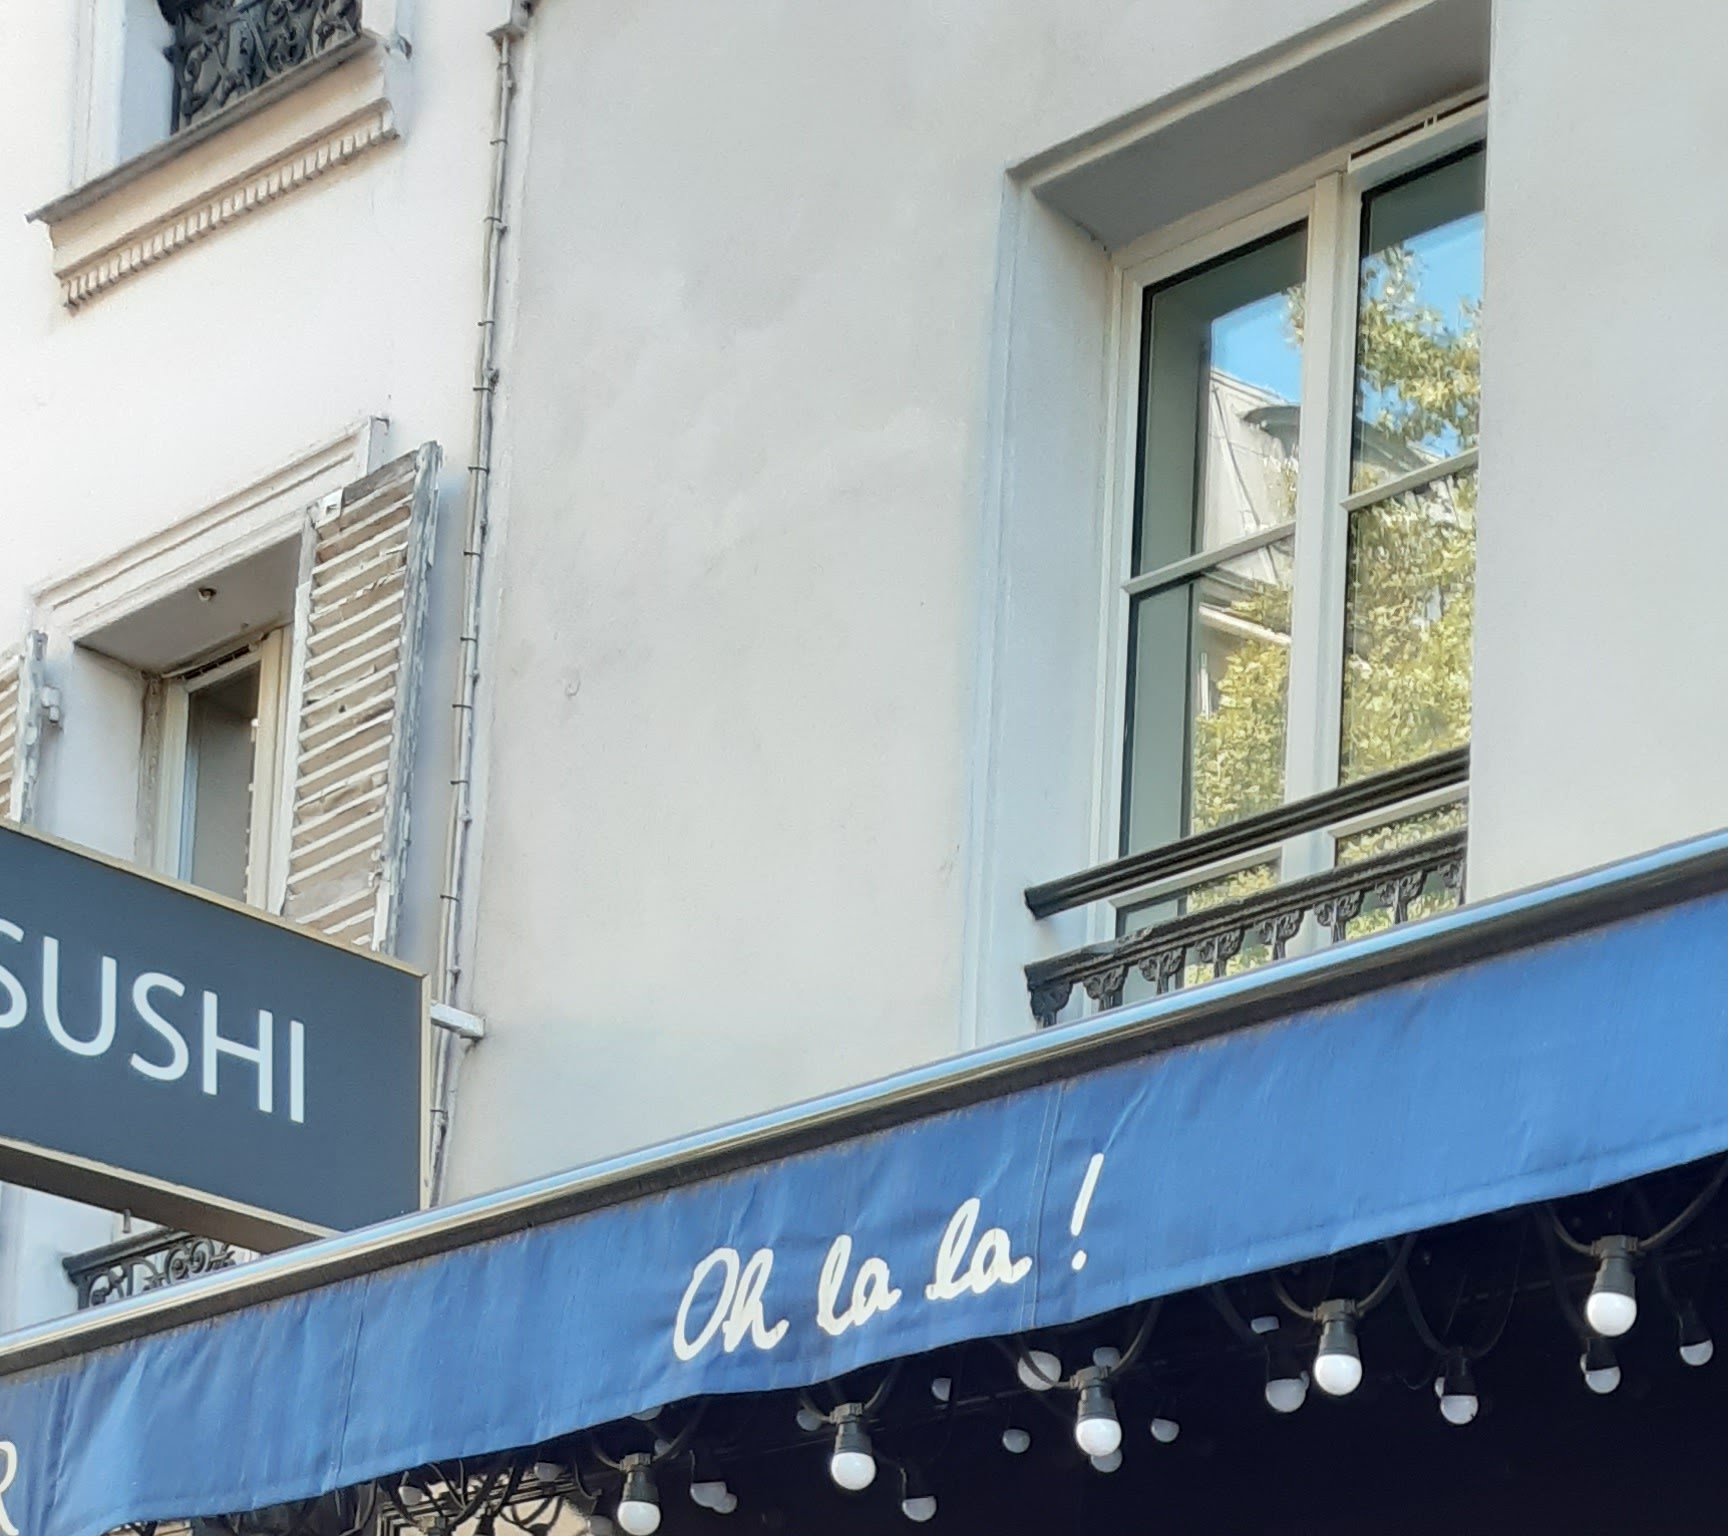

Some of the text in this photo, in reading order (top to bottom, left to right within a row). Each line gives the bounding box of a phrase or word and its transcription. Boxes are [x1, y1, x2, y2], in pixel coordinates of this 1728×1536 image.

[673, 1152, 1105, 1361] Oh la la !
